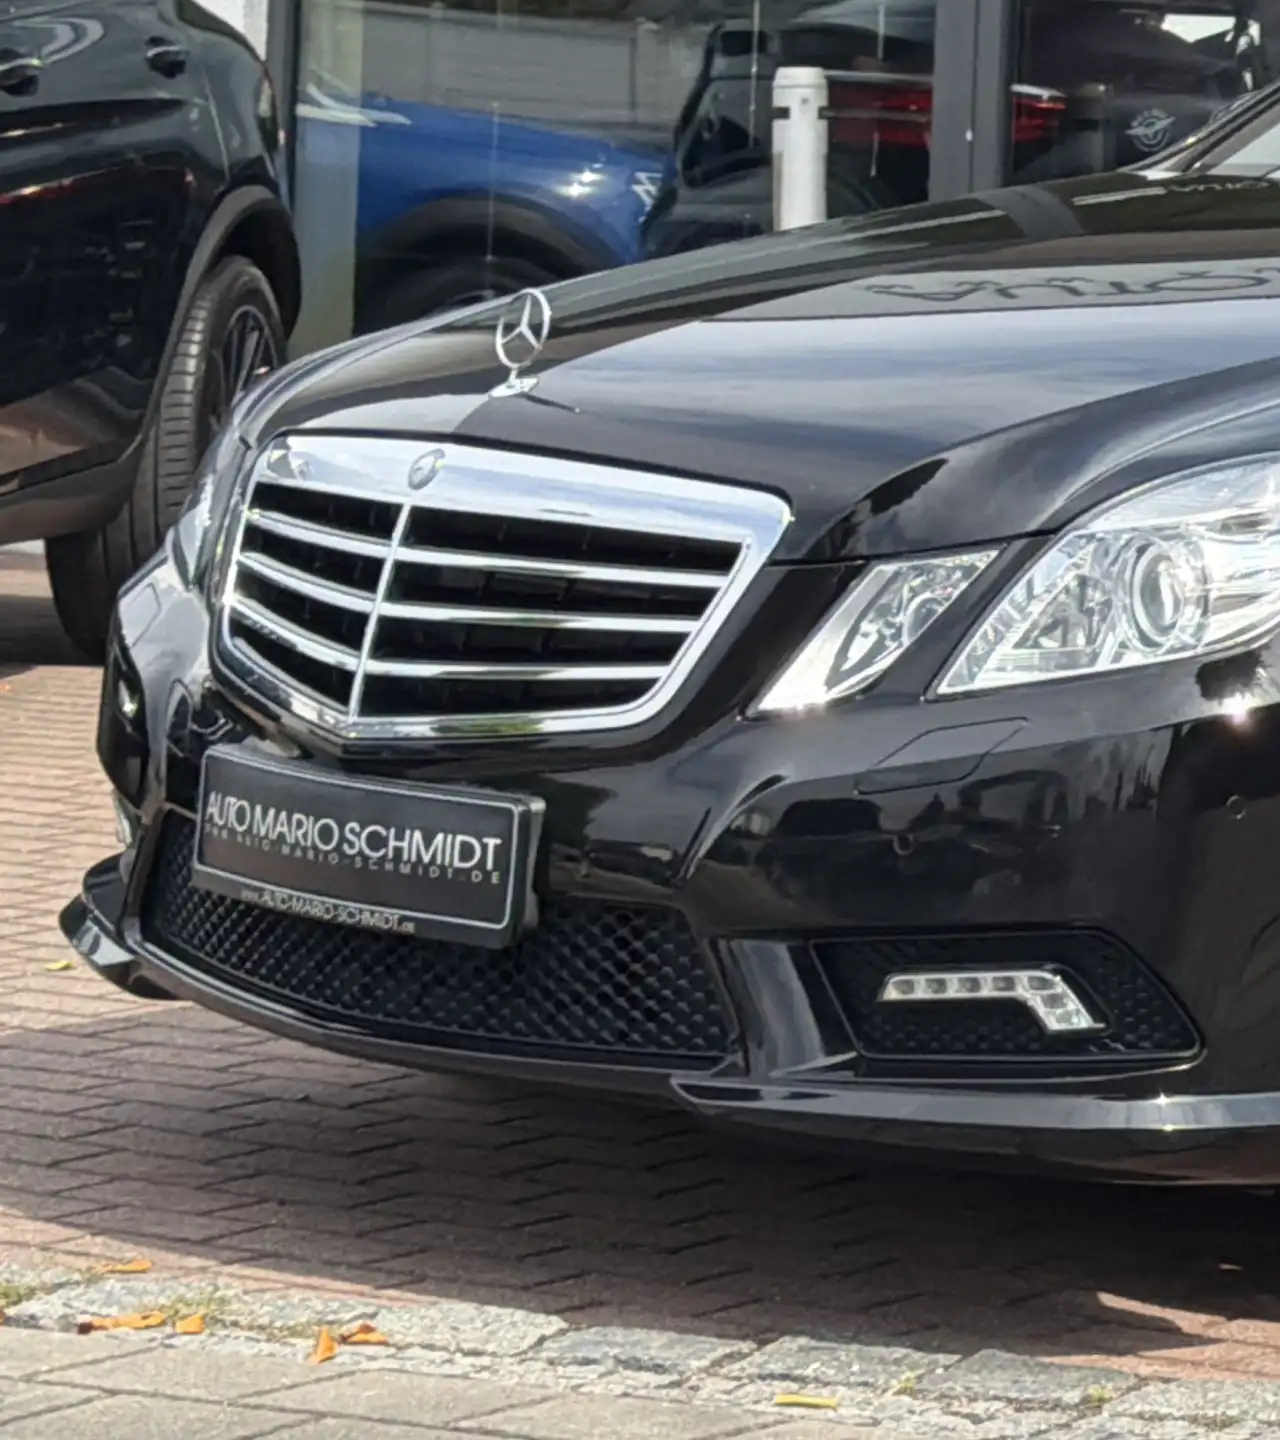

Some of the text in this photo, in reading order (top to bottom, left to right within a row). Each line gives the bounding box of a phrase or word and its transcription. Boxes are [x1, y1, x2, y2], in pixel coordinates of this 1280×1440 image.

[205, 791, 503, 870] AUTO MARIO SCHMIDT
